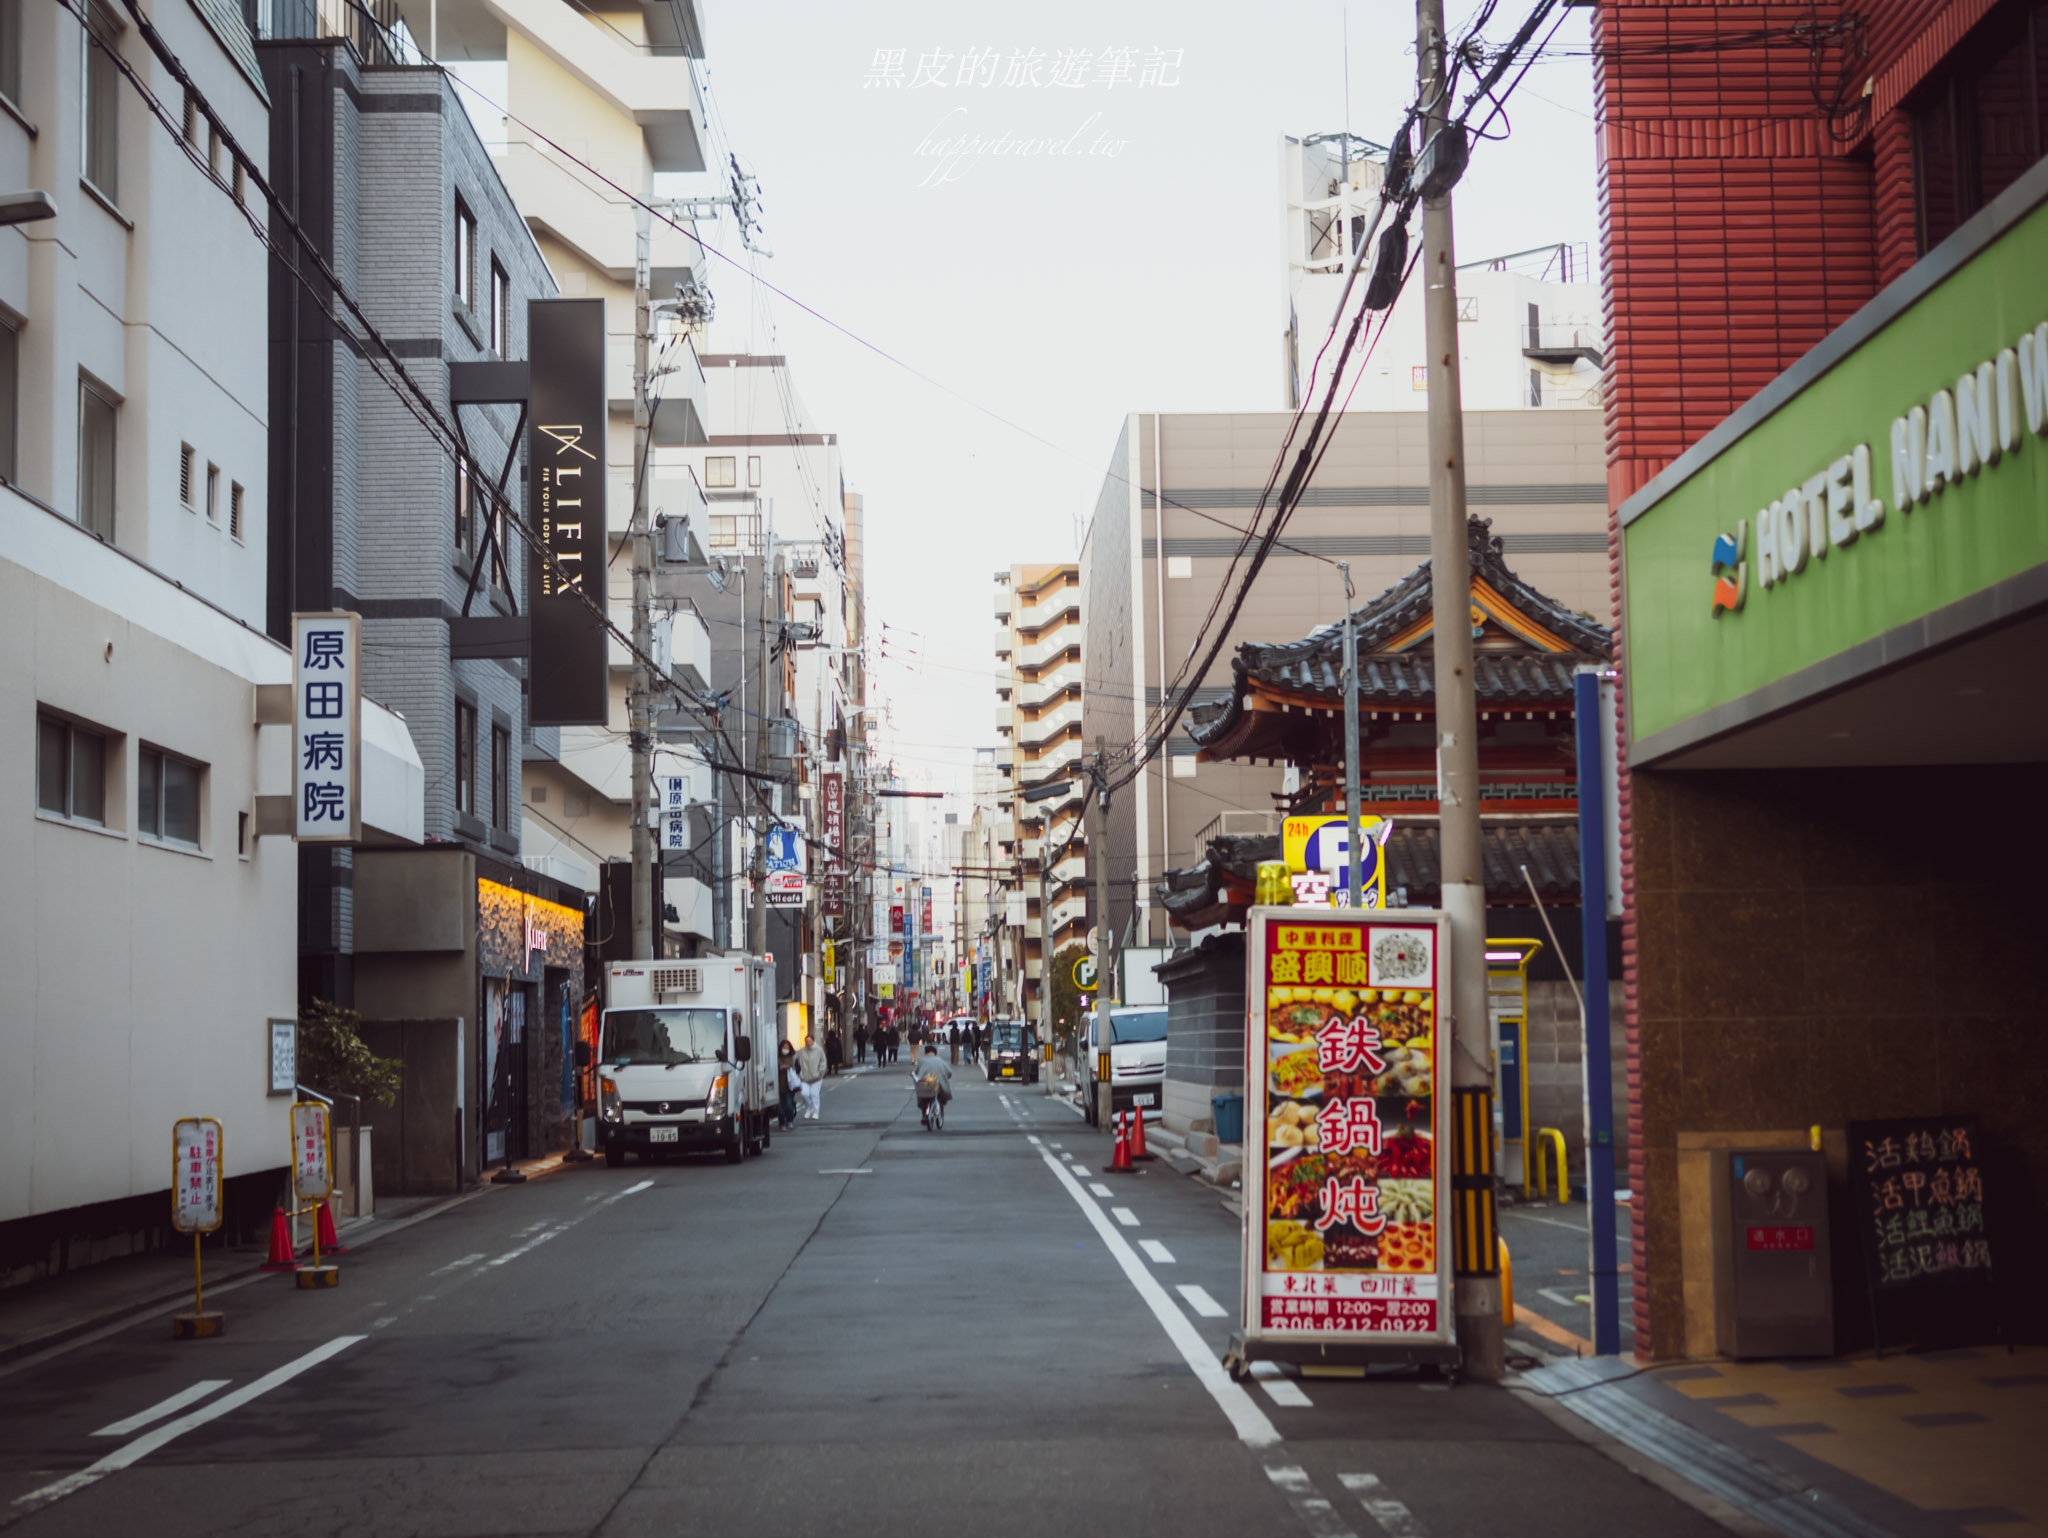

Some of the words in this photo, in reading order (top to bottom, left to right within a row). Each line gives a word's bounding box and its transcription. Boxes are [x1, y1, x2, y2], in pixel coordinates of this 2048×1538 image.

[556, 466, 582, 595] LIFIX
[1756, 444, 1885, 588] HOTEL
[543, 575, 551, 595] LIFE
[304, 631, 344, 822] 原田病院
[1288, 823, 1309, 837] 24h
[1286, 931, 1354, 947] 中華料理
[1316, 1017, 1387, 1234] 鉄鍋炖
[190, 1146, 201, 1206] 駐車禁止
[1284, 1275, 1337, 1294] 東北菜
[1361, 1277, 1416, 1296] 四川菜
[1270, 1299, 1329, 1315] 営業時間
